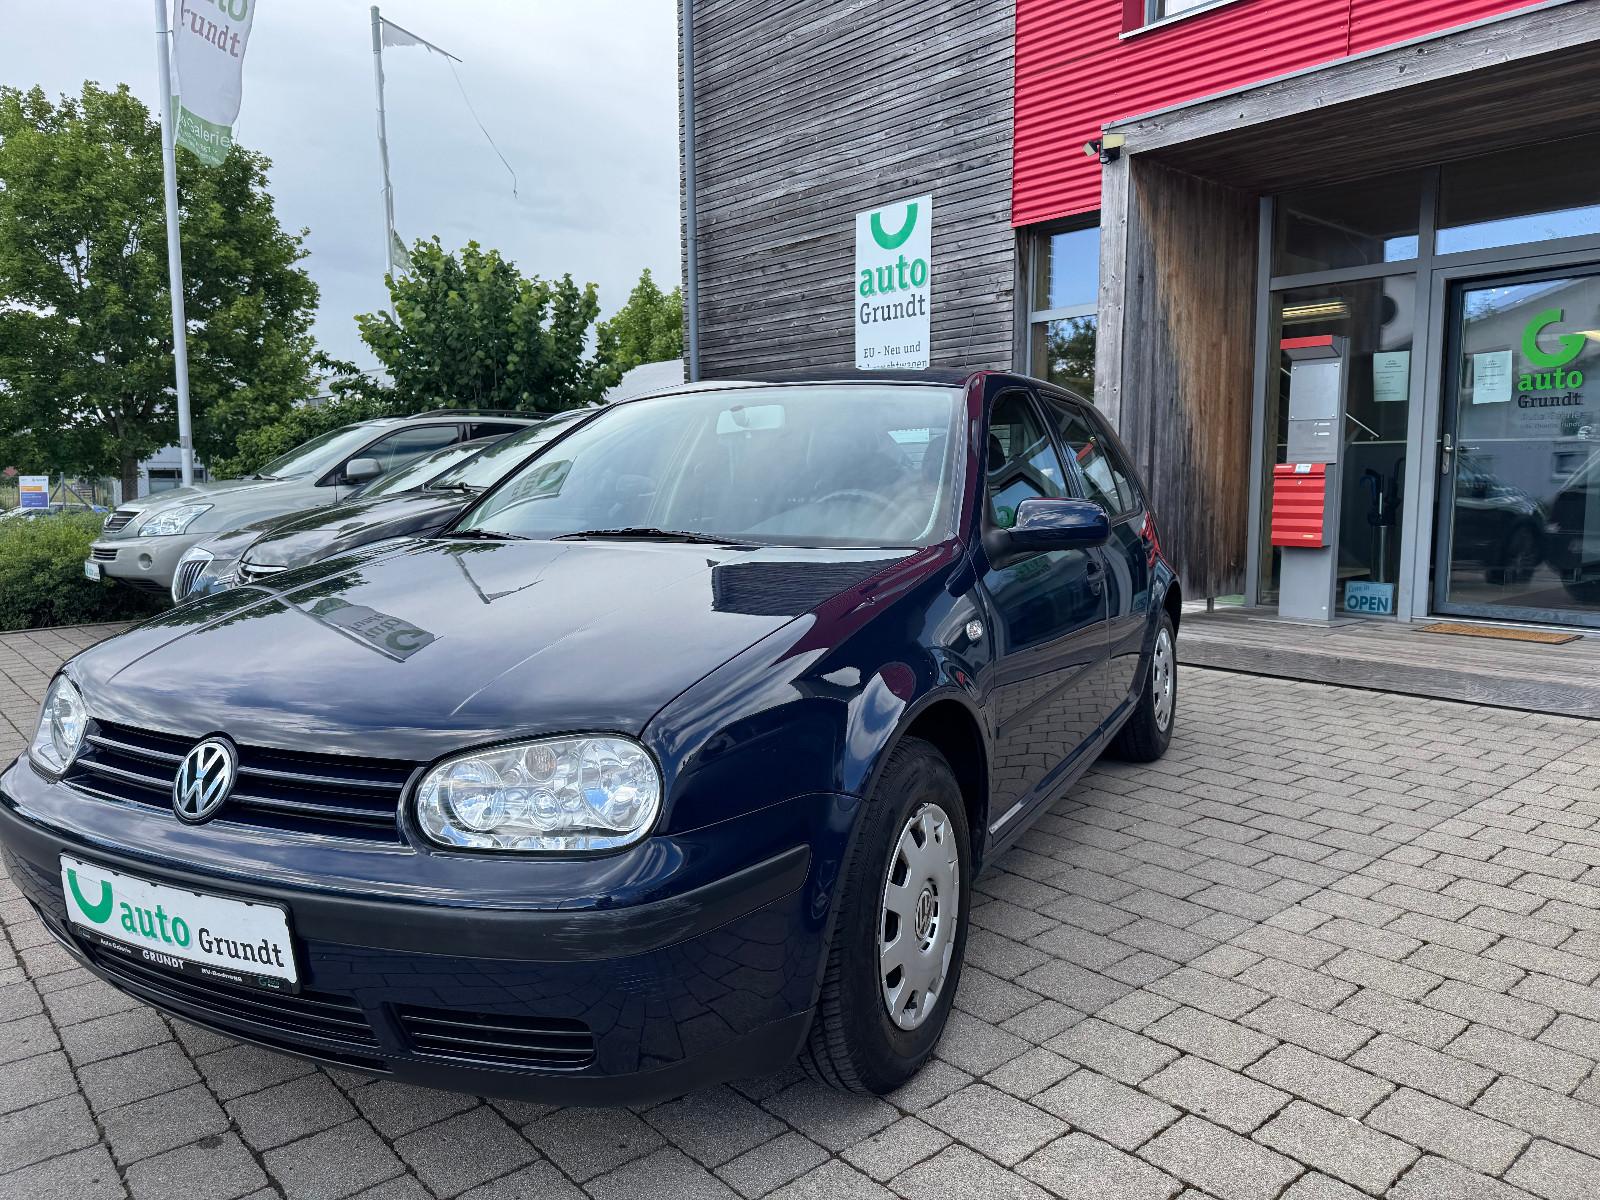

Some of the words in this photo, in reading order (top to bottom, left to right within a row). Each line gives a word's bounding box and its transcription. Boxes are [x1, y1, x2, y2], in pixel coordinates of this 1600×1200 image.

[182, 8, 240, 57] rundt
[859, 254, 928, 298] auto
[860, 293, 926, 324] Grundt
[863, 347, 875, 359] EU
[884, 345, 900, 356] Neu
[903, 340, 921, 354] und
[1517, 367, 1583, 391] auto
[1518, 392, 1583, 408] Grundt
[1347, 595, 1389, 611] OPEN
[120, 901, 192, 948] auto
[199, 927, 285, 968] Grundt
[142, 949, 185, 970] GRUNDT
